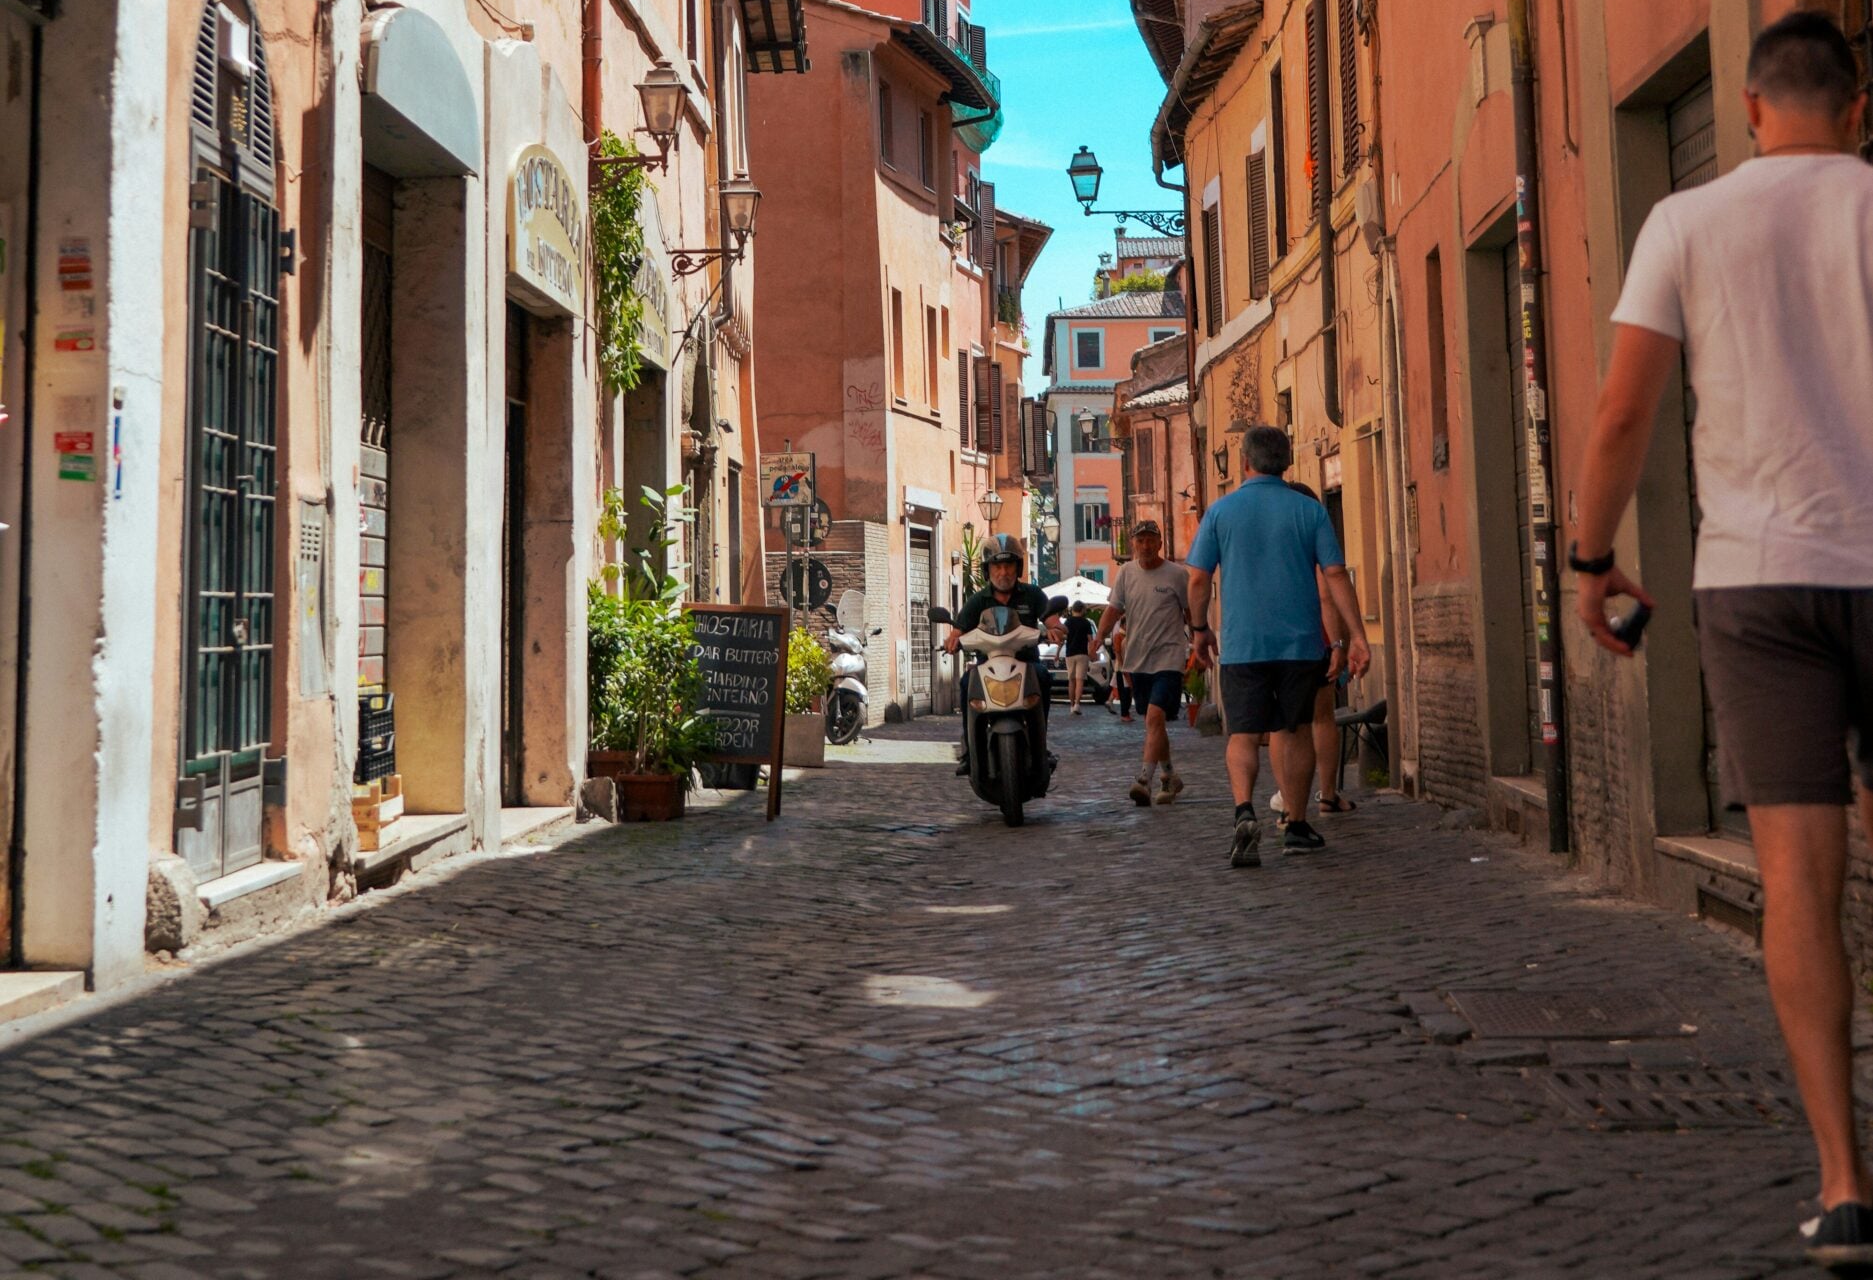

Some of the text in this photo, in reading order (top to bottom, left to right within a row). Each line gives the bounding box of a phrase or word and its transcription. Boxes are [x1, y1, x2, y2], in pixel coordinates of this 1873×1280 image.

[517, 157, 582, 278] HOSTARIA
[694, 614, 774, 640] HOSTARIA
[693, 644, 720, 661] DAR
